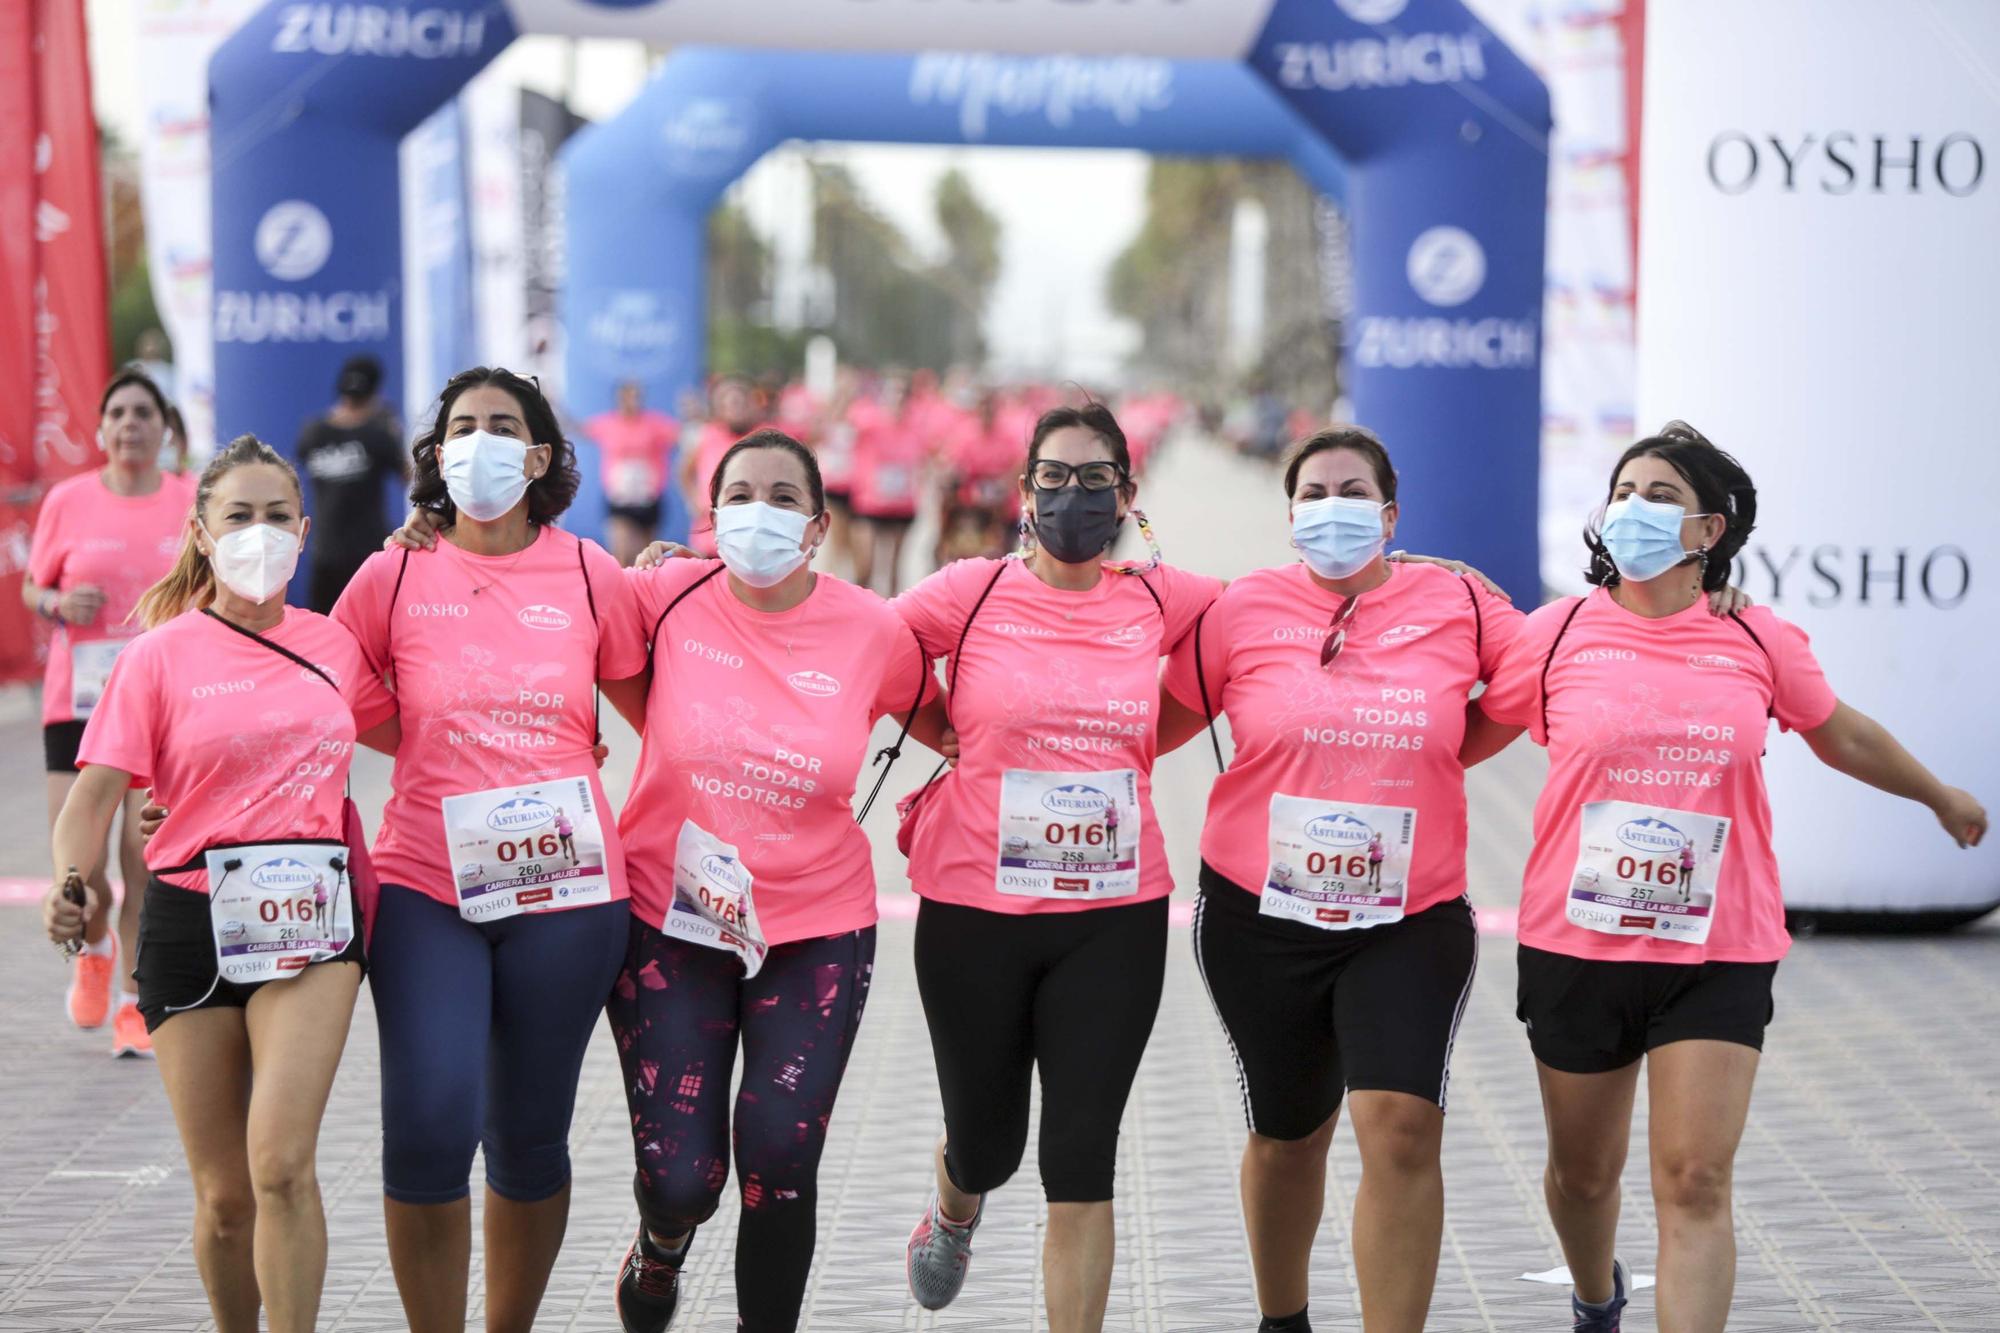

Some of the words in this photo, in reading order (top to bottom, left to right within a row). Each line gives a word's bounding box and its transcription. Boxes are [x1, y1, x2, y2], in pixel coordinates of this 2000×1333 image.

[275, 4, 486, 58] ZURICH
[1277, 34, 1487, 90] ZURICH
[1707, 130, 1984, 196] OYSHO
[216, 290, 389, 334] ZURICH
[1356, 316, 1535, 368] ZURICH
[407, 603, 469, 617] OYSHO
[684, 639, 744, 669] OYSHO
[1574, 649, 1636, 664] OYSHO
[192, 680, 256, 698] OYSHO
[1381, 688, 1427, 704] POR
[519, 690, 565, 709] POR
[1107, 700, 1149, 715] POR
[1076, 718, 1147, 736] TODAS
[1353, 708, 1427, 727] TODAS
[448, 730, 557, 748] NOSOTRAS
[1303, 728, 1424, 750] NOSOTRAS
[1687, 725, 1735, 741] POR
[774, 749, 822, 774] POR
[1656, 746, 1731, 765] TODAS
[742, 761, 817, 793] TODAS
[1608, 768, 1723, 787] NOSOTRAS
[691, 773, 807, 809] NOSOTRAS
[1047, 794, 1106, 809] ASTURIANA
[493, 809, 551, 827] ASTURIANA
[1045, 822, 1104, 846] 016
[1310, 824, 1368, 841] ASTURIANA
[1621, 827, 1681, 848] ASTURIANA
[497, 834, 559, 862] 016
[1062, 851, 1084, 863] 258
[518, 864, 542, 877] 260
[1065, 863, 1076, 871] DE
[1078, 863, 1089, 871] LA
[1307, 852, 1366, 878] 016
[1617, 856, 1676, 885] 016
[257, 870, 313, 884] ASTURIANA
[485, 878, 523, 892] CARRERA
[525, 876, 537, 885] DE
[538, 874, 550, 883] LA
[551, 868, 581, 881] MUJER
[1003, 874, 1047, 888] OYSHO
[1322, 880, 1345, 892] 259
[1326, 893, 1338, 902] DE
[1339, 895, 1350, 903] LA
[1351, 895, 1381, 905] MUJER
[1630, 887, 1654, 900] 257
[259, 898, 313, 923] 016
[467, 897, 511, 916] OYSHO
[699, 886, 736, 925] 016
[1267, 896, 1311, 915] OYSHO
[1594, 894, 1632, 908] CARRERA
[1633, 901, 1646, 909] DE
[1646, 902, 1659, 911] LA
[1659, 904, 1689, 914] MUJER
[1571, 907, 1615, 924] OYSHO
[671, 917, 716, 937] OYSHO
[247, 942, 285, 952] CARRERA
[226, 960, 271, 976] OYSHO
